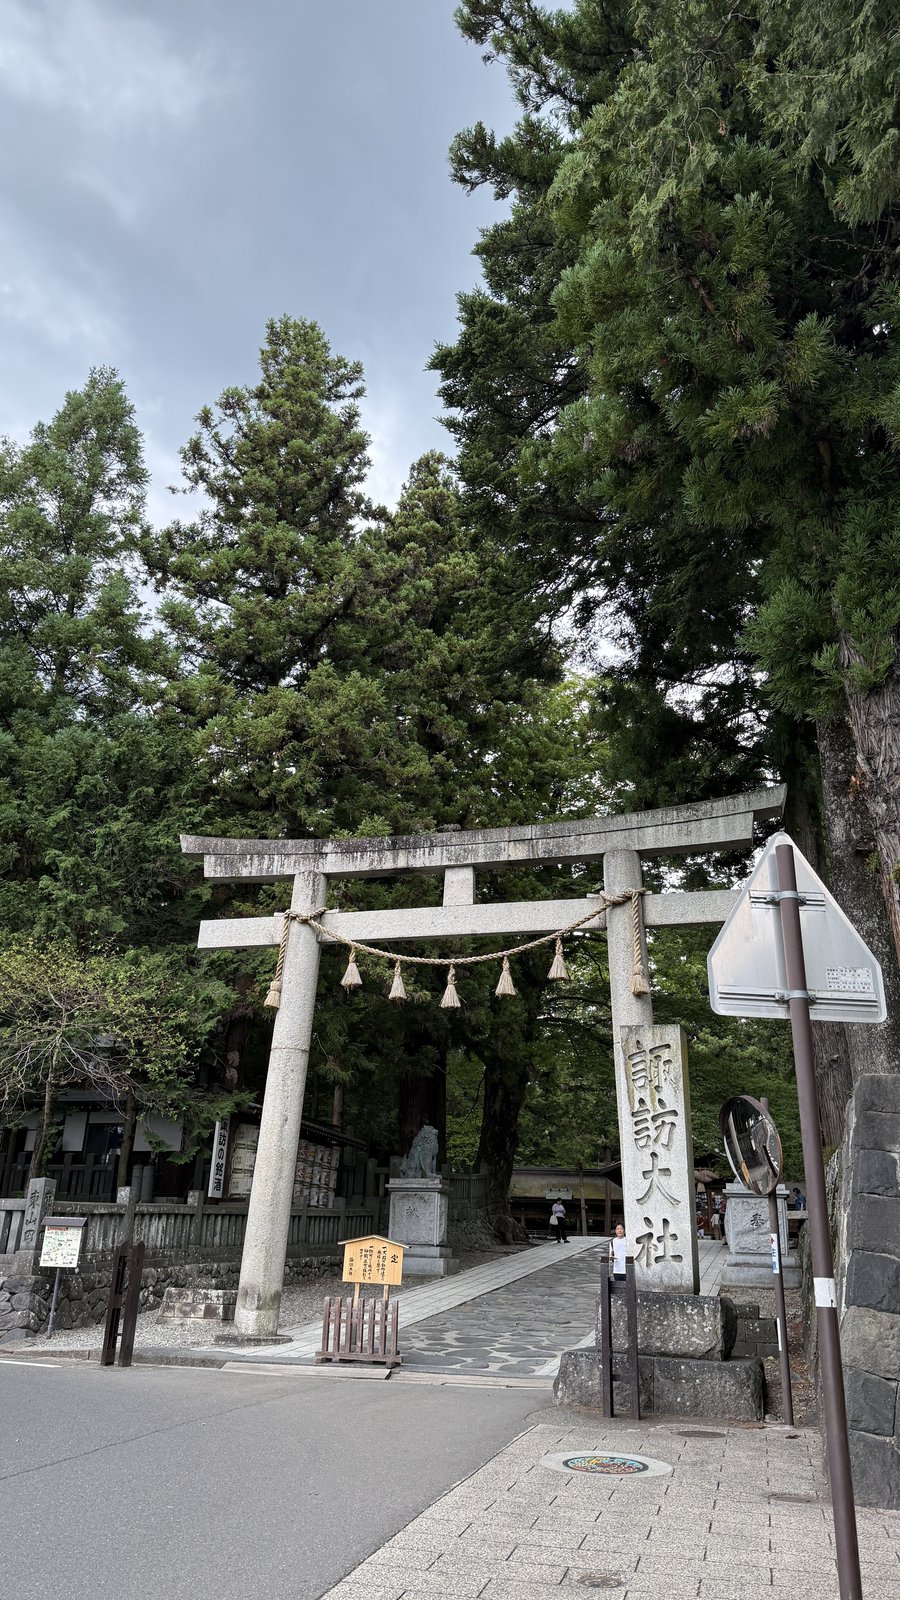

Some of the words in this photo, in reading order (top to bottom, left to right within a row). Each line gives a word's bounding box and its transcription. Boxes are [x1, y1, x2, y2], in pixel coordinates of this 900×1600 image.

[628, 1039, 683, 1267] 諏訪大社
[24, 1190, 40, 1241] 東山田
[750, 1213, 765, 1227] 奉
